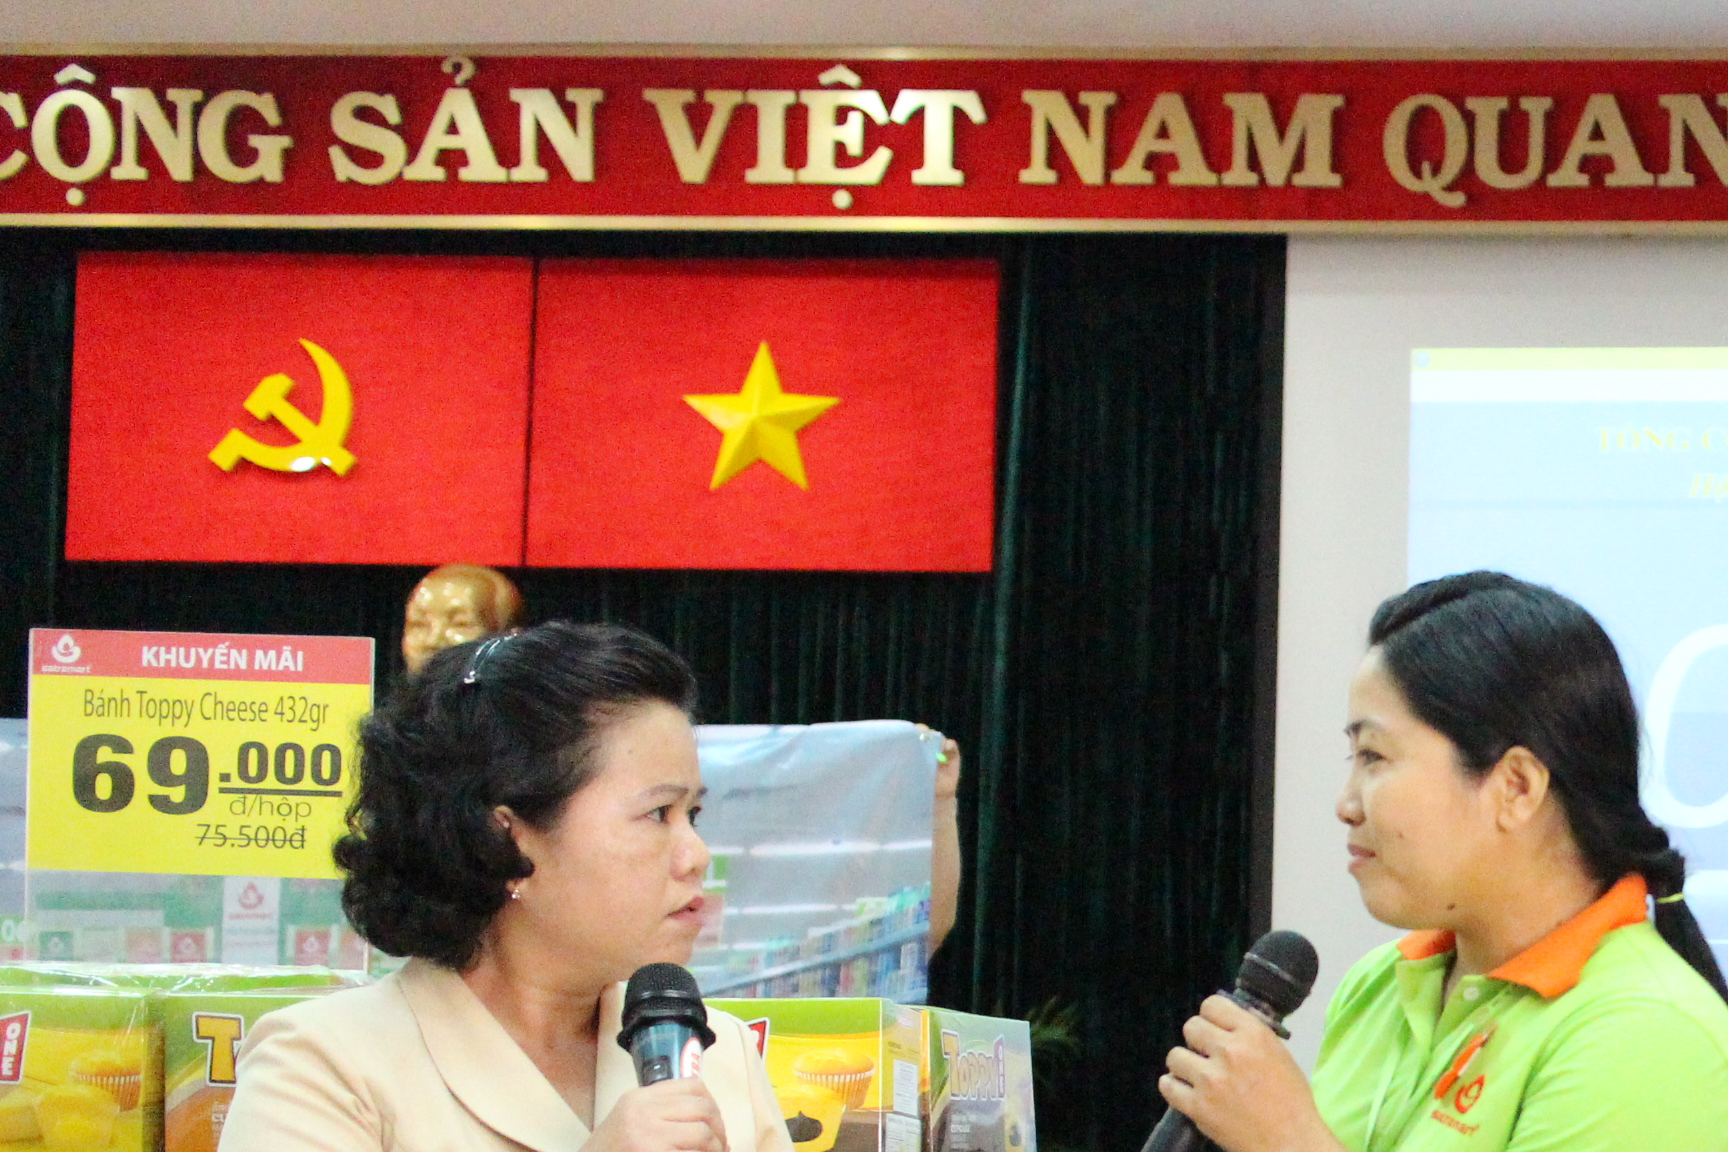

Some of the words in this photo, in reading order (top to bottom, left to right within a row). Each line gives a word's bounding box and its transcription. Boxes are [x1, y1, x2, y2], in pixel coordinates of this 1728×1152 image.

[328, 54, 603, 187] SẢN
[643, 64, 987, 210] VIỆT
[1019, 89, 1345, 187] NAM
[141, 641, 248, 671] KHUYẾN
[253, 645, 304, 672] MÃI
[83, 688, 131, 719] Bánh
[136, 690, 195, 728] Toppy
[200, 691, 269, 722] Cheese
[274, 695, 330, 732] 432gr
[229, 794, 312, 822] đ/hộp
[196, 823, 307, 850] 75.500đ
[1, 1022, 22, 1076] ONE
